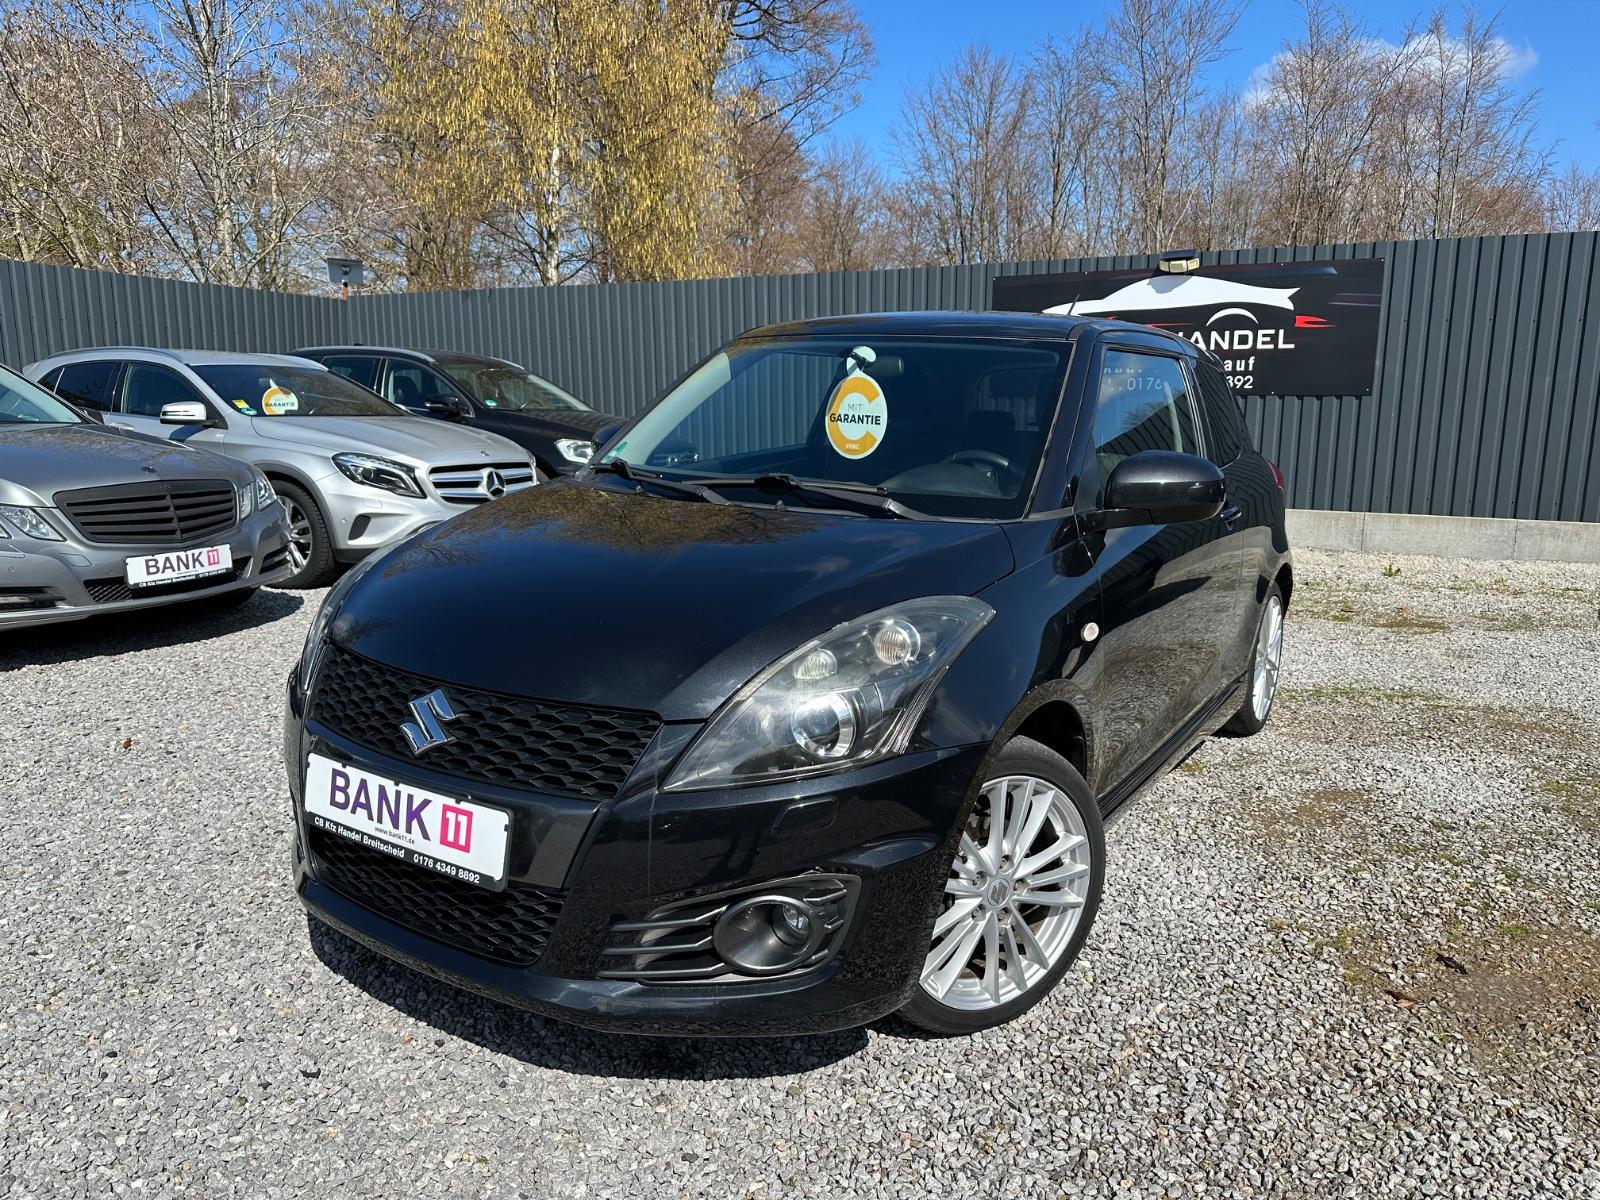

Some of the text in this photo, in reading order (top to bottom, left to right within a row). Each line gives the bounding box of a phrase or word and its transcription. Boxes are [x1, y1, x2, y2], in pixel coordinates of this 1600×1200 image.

[1178, 329, 1296, 351] ANDEL
[829, 413, 881, 425] GARANTIE
[847, 403, 863, 412] MIT
[144, 551, 205, 576] BANK
[329, 768, 469, 848] BANK 11
[314, 816, 480, 883] CB Kfz Handel Breitscheid 0176 4349 8892
